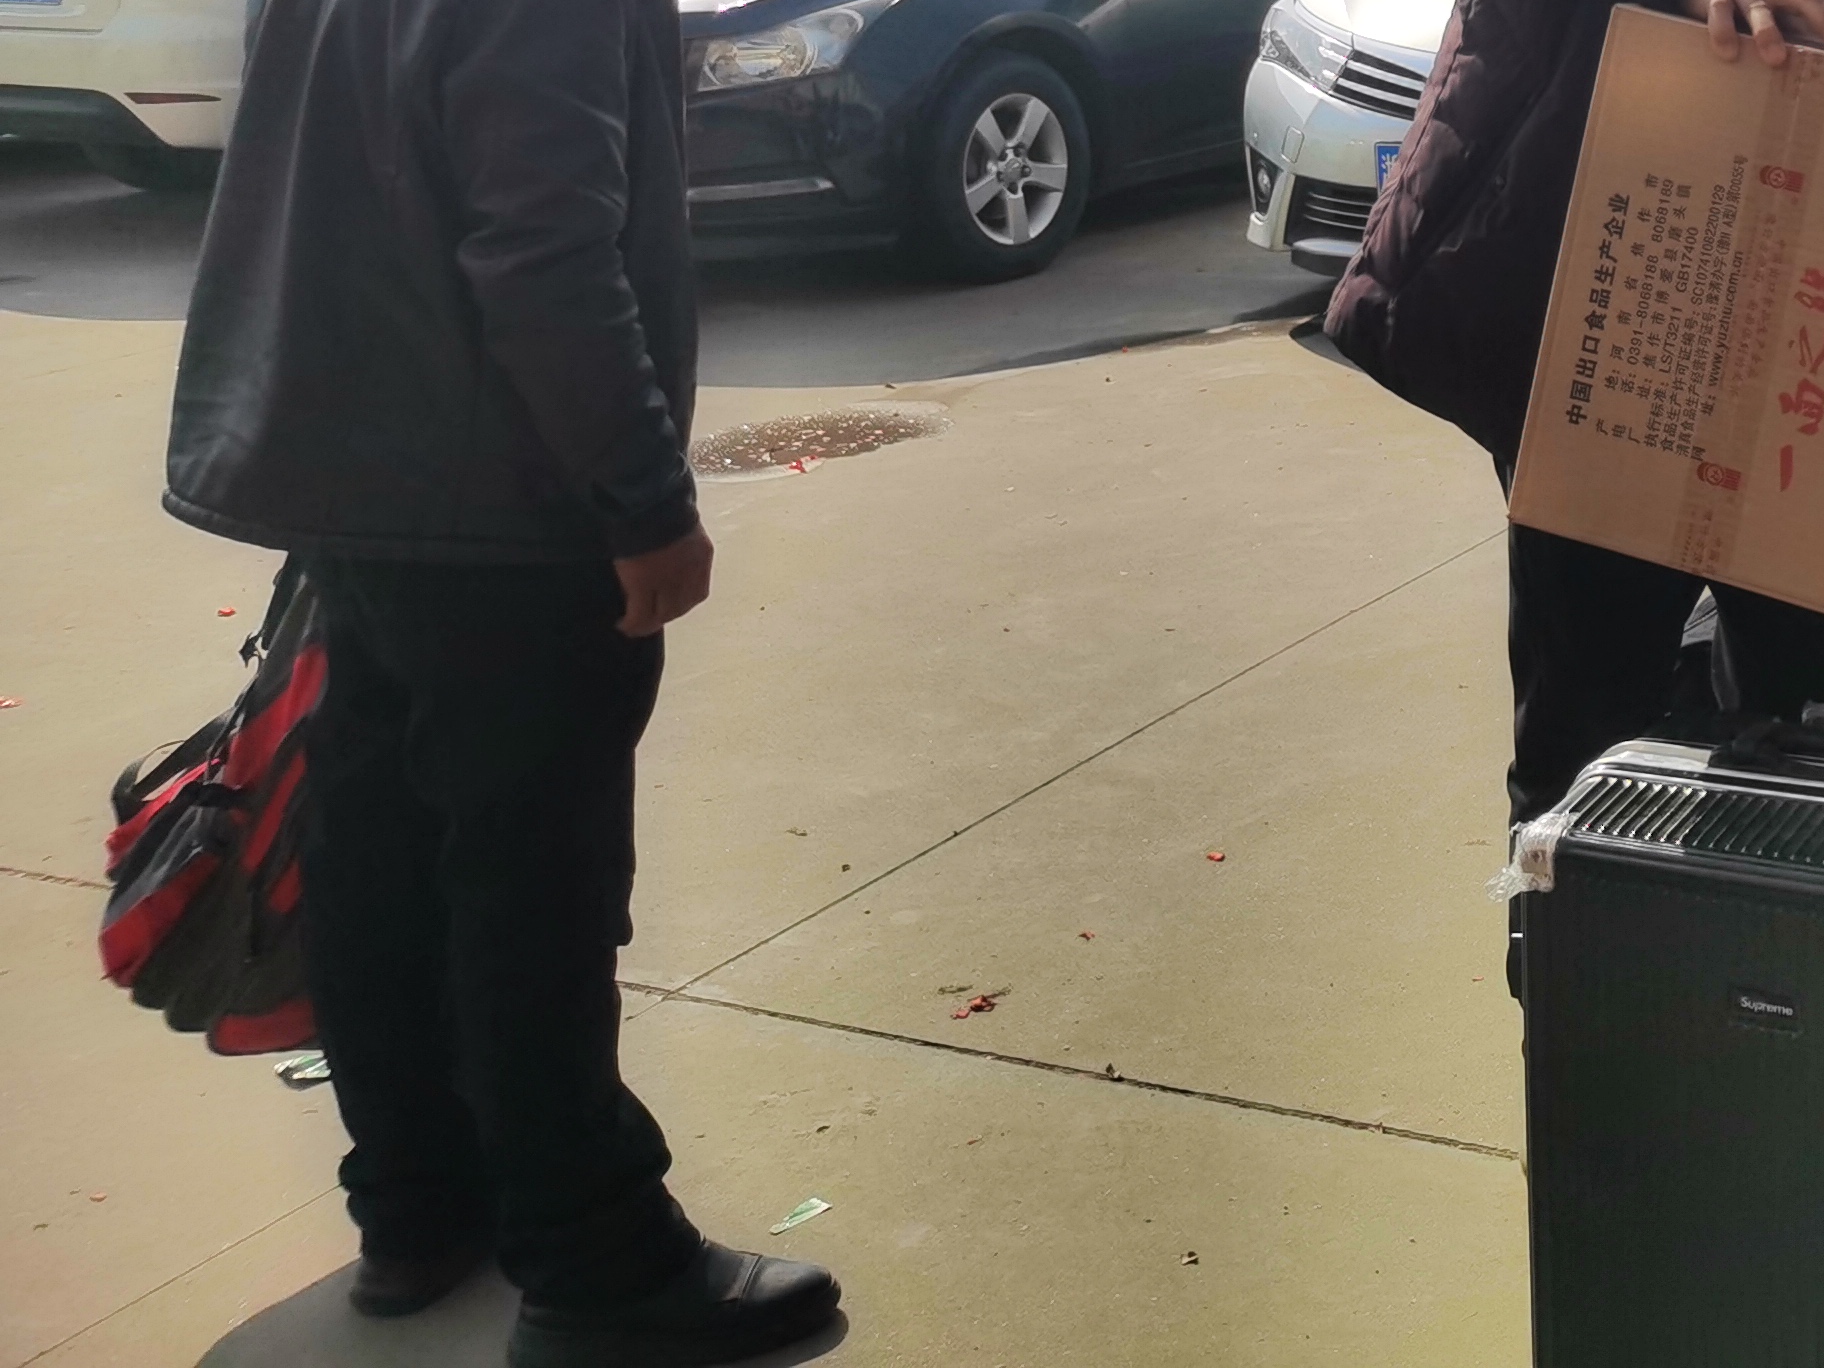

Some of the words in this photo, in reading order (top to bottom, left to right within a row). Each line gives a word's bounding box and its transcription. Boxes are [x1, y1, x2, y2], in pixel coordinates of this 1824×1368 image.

[1650, 177, 1674, 243] 8068189
[1674, 225, 1700, 293] GB17400
[1563, 189, 1631, 427] 中国出口食品生产企业
[1740, 996, 1794, 1017] Supreme
